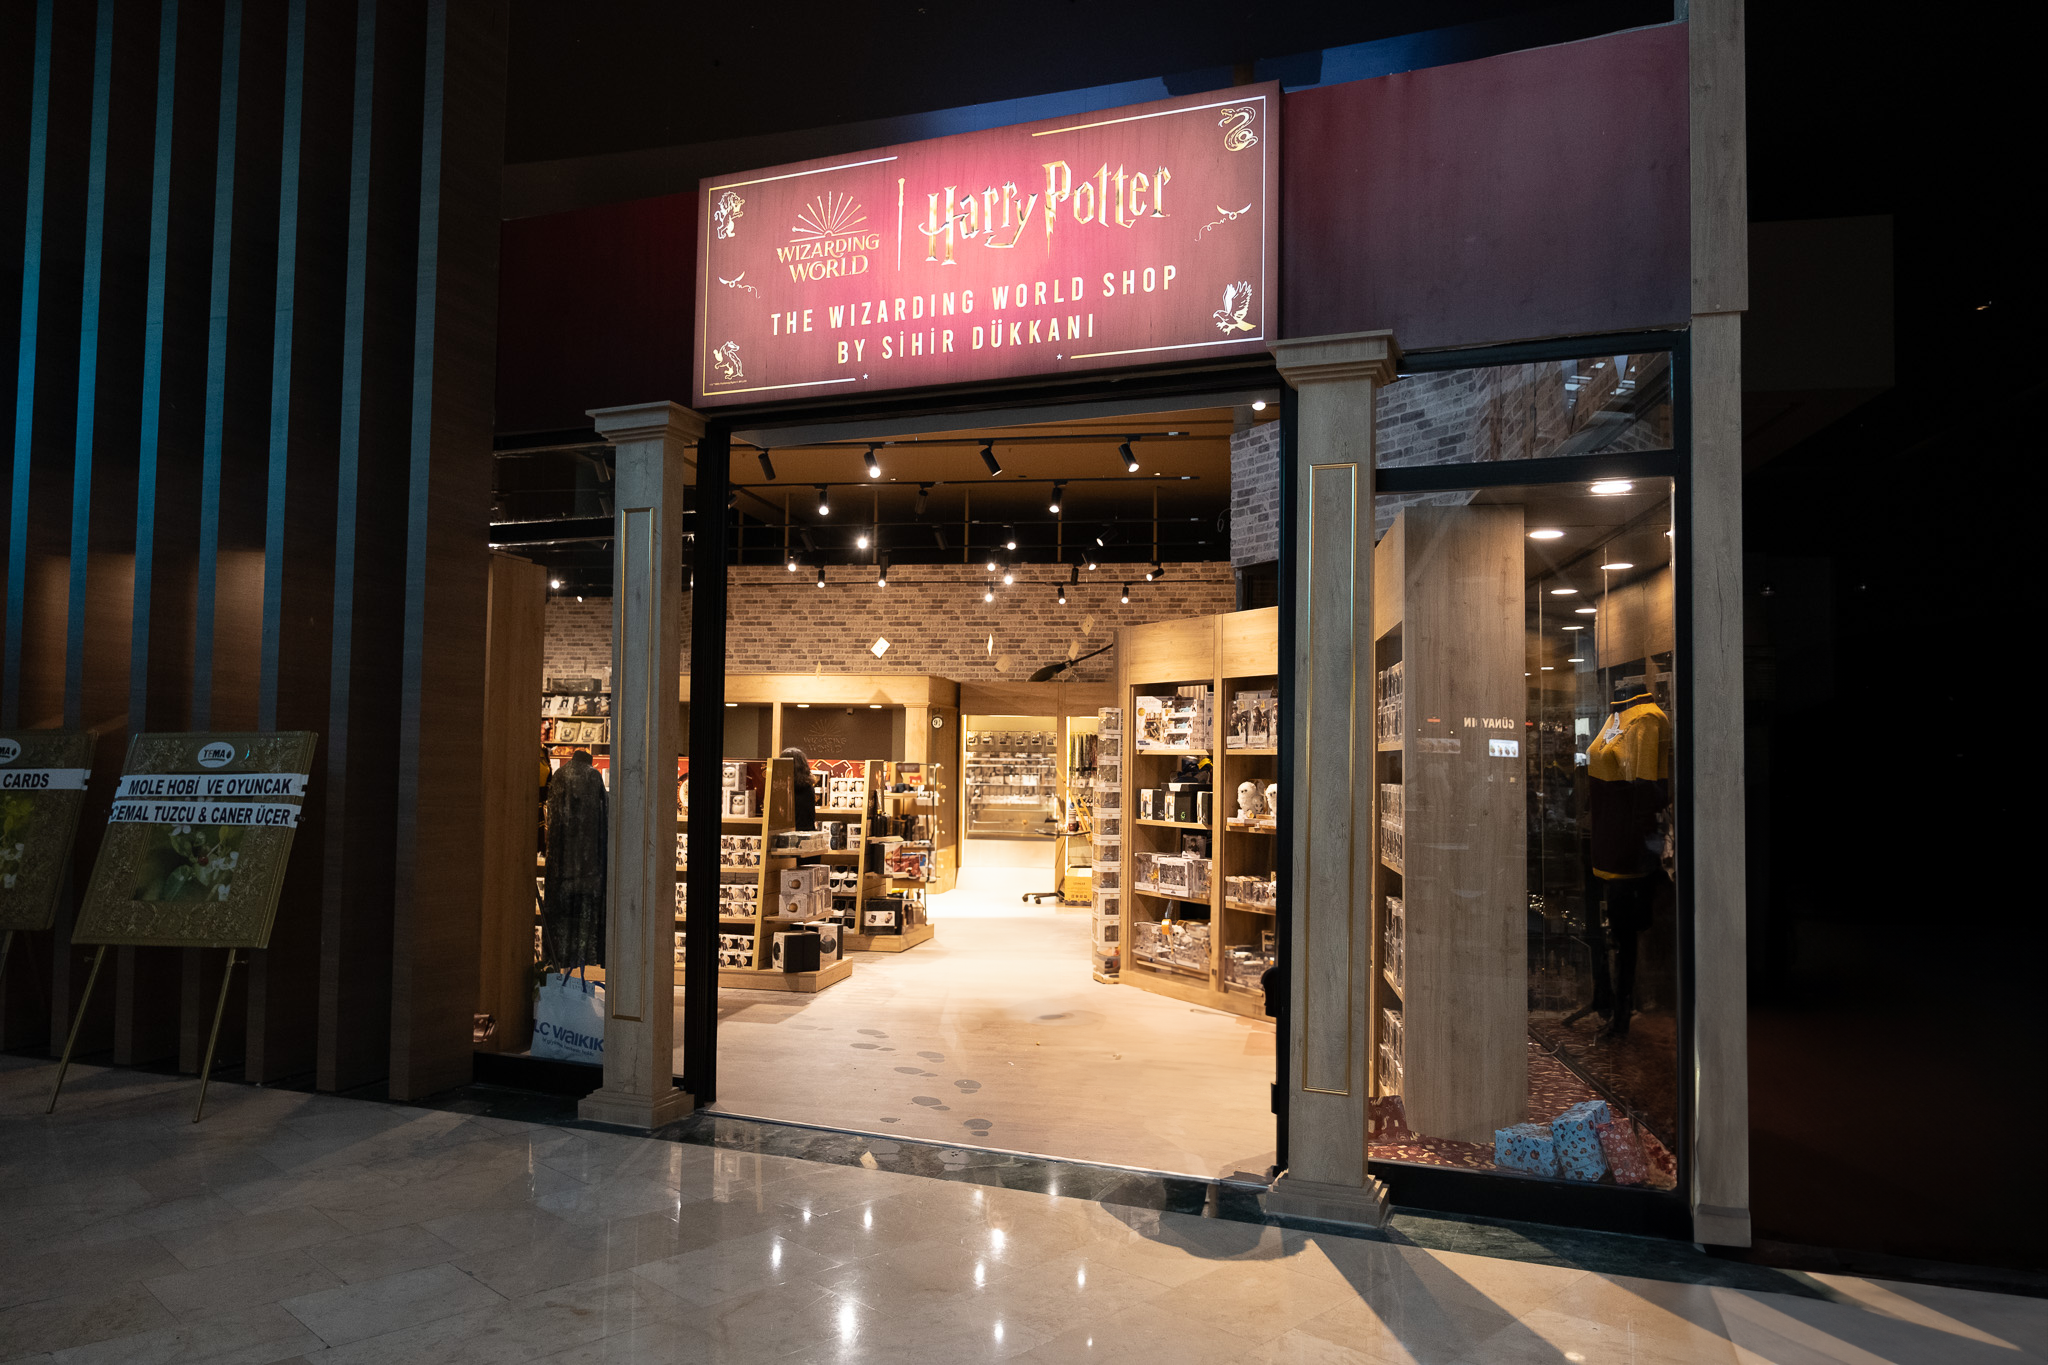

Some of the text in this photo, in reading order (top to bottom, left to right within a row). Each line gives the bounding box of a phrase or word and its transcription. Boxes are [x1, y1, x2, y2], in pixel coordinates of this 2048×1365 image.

[918, 160, 1172, 266] Harry Potter
[776, 233, 880, 264] WIZARDING
[789, 254, 869, 284] WORLD
[770, 264, 1177, 336] THE WIZARDING WORLD SHOP
[837, 313, 1094, 365] BY SİHİR DÜKKANI
[203, 749, 226, 759] TEMA
[3, 773, 50, 788] CARDS
[128, 776, 293, 795] MOLE HOBİ VE OYUNCAK
[111, 804, 291, 827] CEMAL TUZCU & CANER ÜÇER
